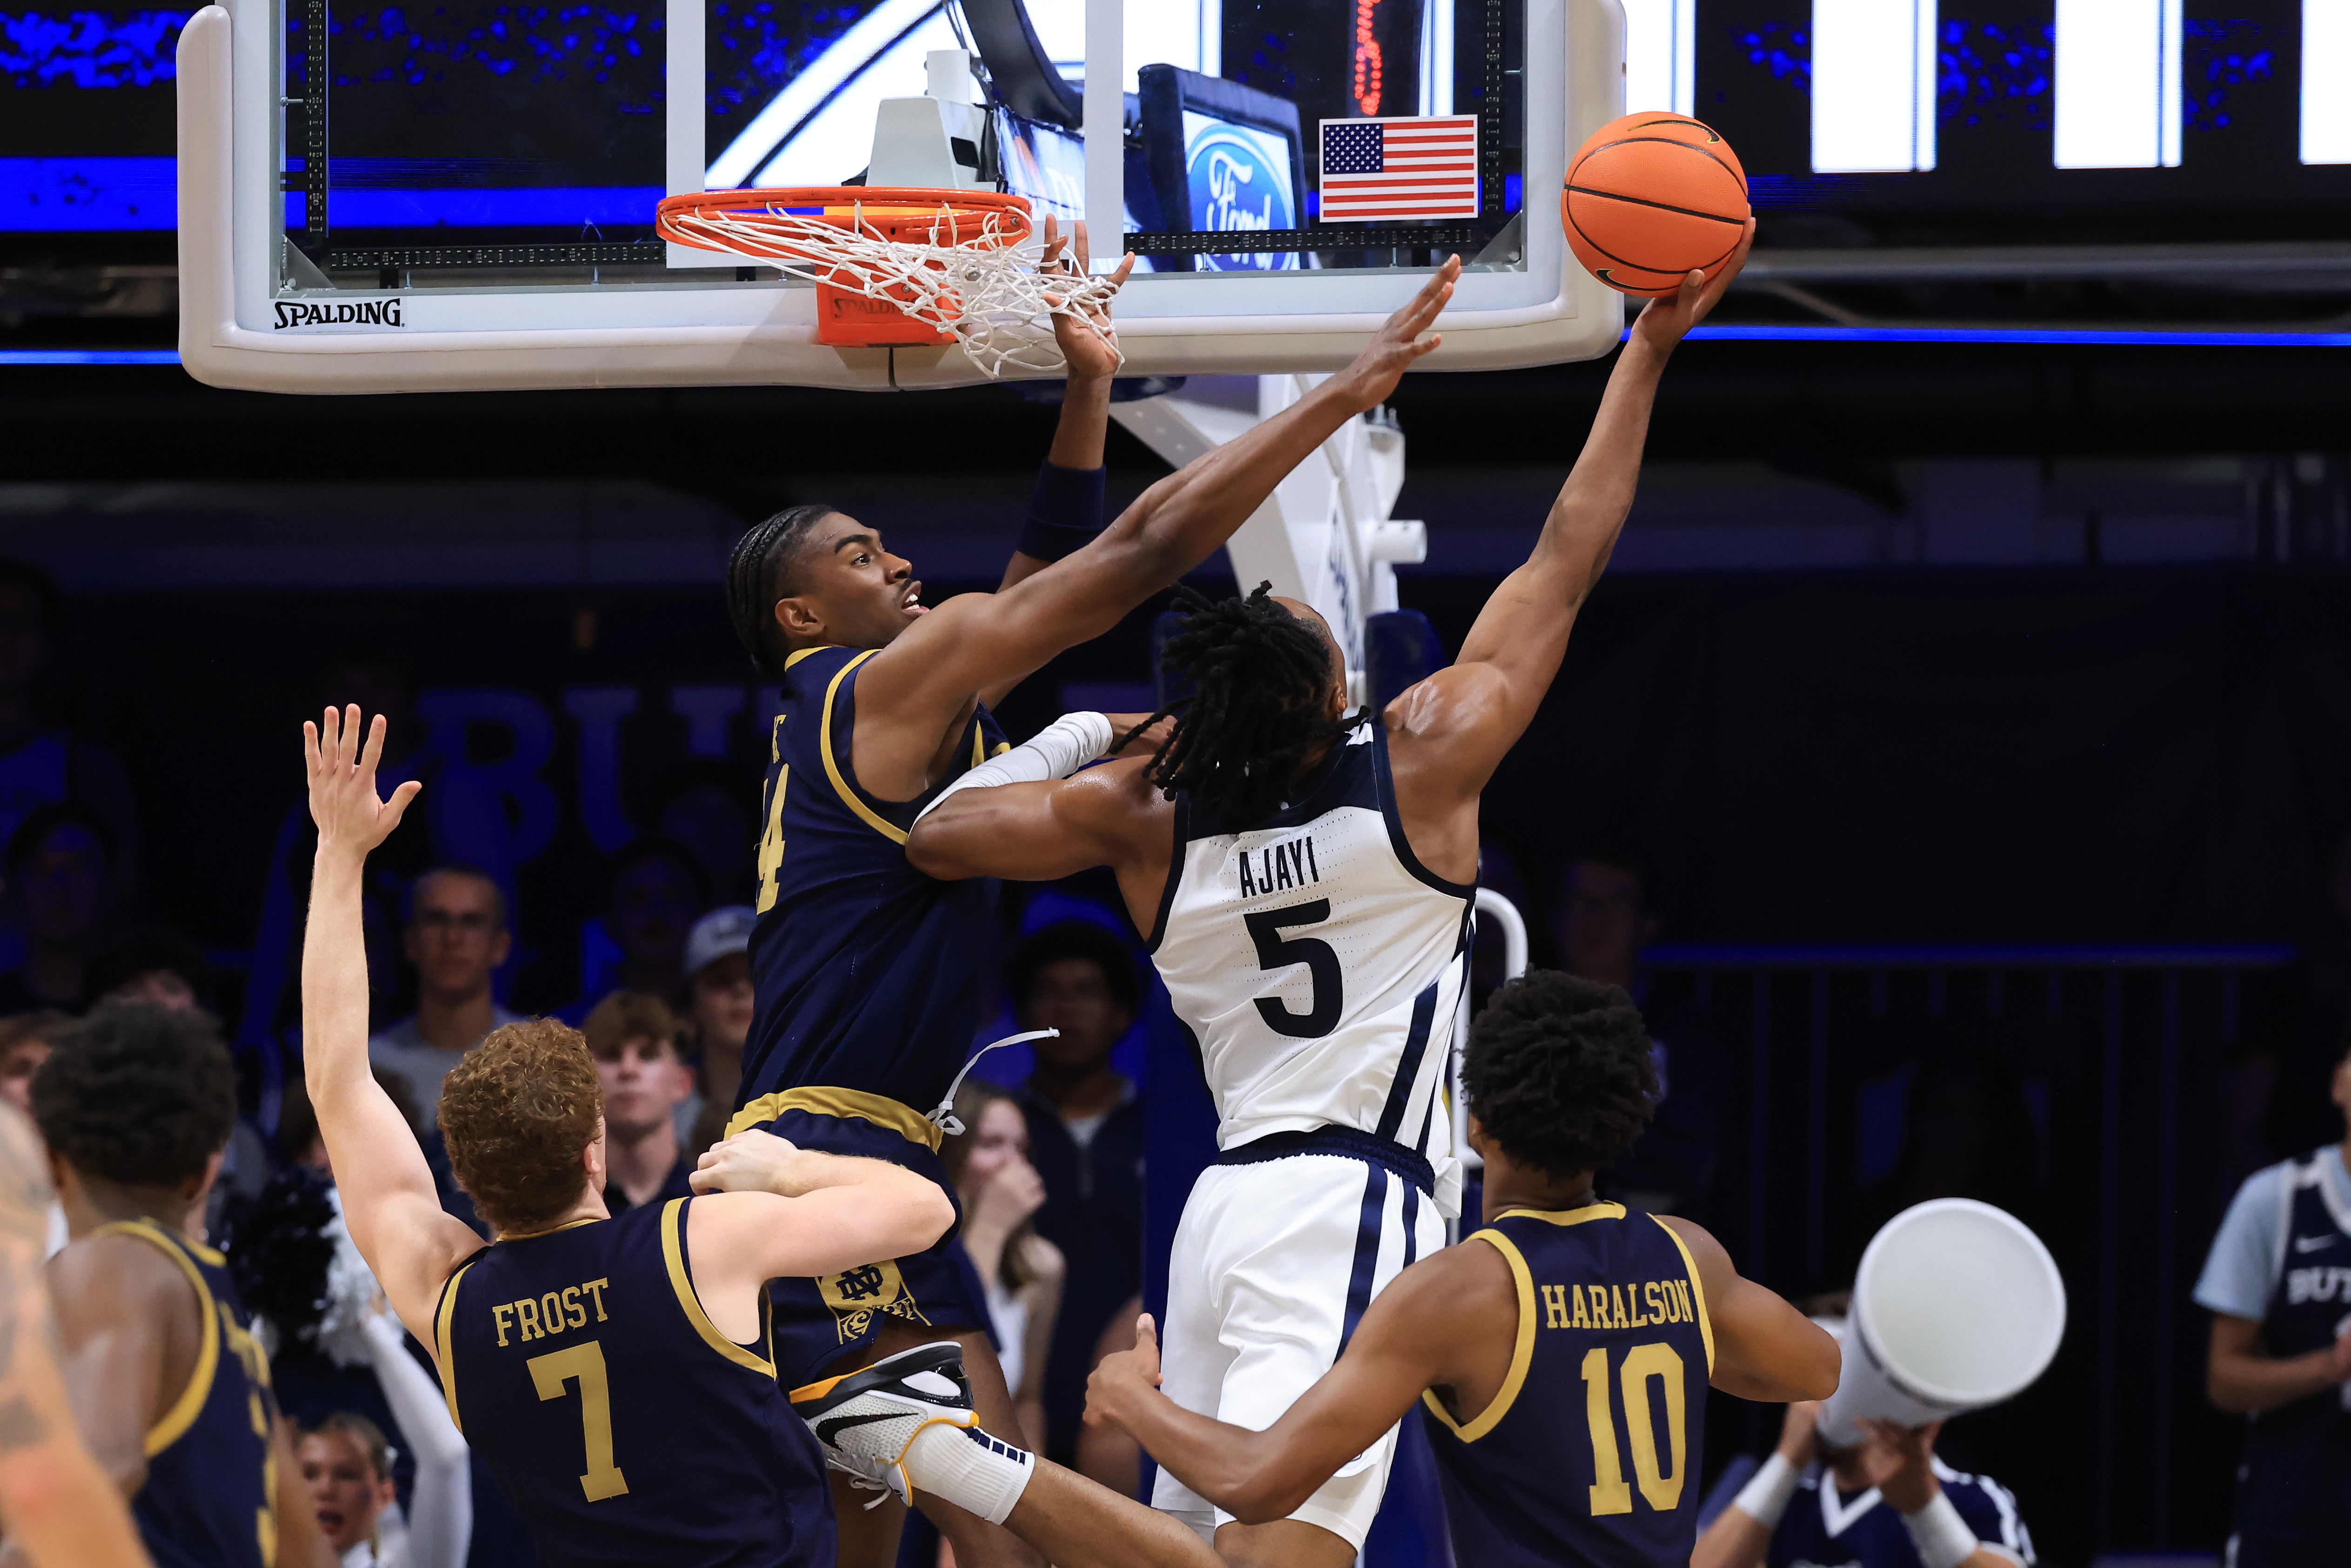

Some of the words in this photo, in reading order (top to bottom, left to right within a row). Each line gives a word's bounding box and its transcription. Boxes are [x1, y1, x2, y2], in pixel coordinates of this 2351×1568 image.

[1206, 150, 1273, 271] Ford
[274, 298, 401, 330] SPALDING
[1239, 836, 1320, 899] AJAYI
[1243, 897, 1343, 1039] 5
[492, 1277, 608, 1347] FROST
[1541, 1280, 1694, 1329] HARALSON
[526, 1340, 629, 1502] 7
[1581, 1342, 1686, 1516] 10
